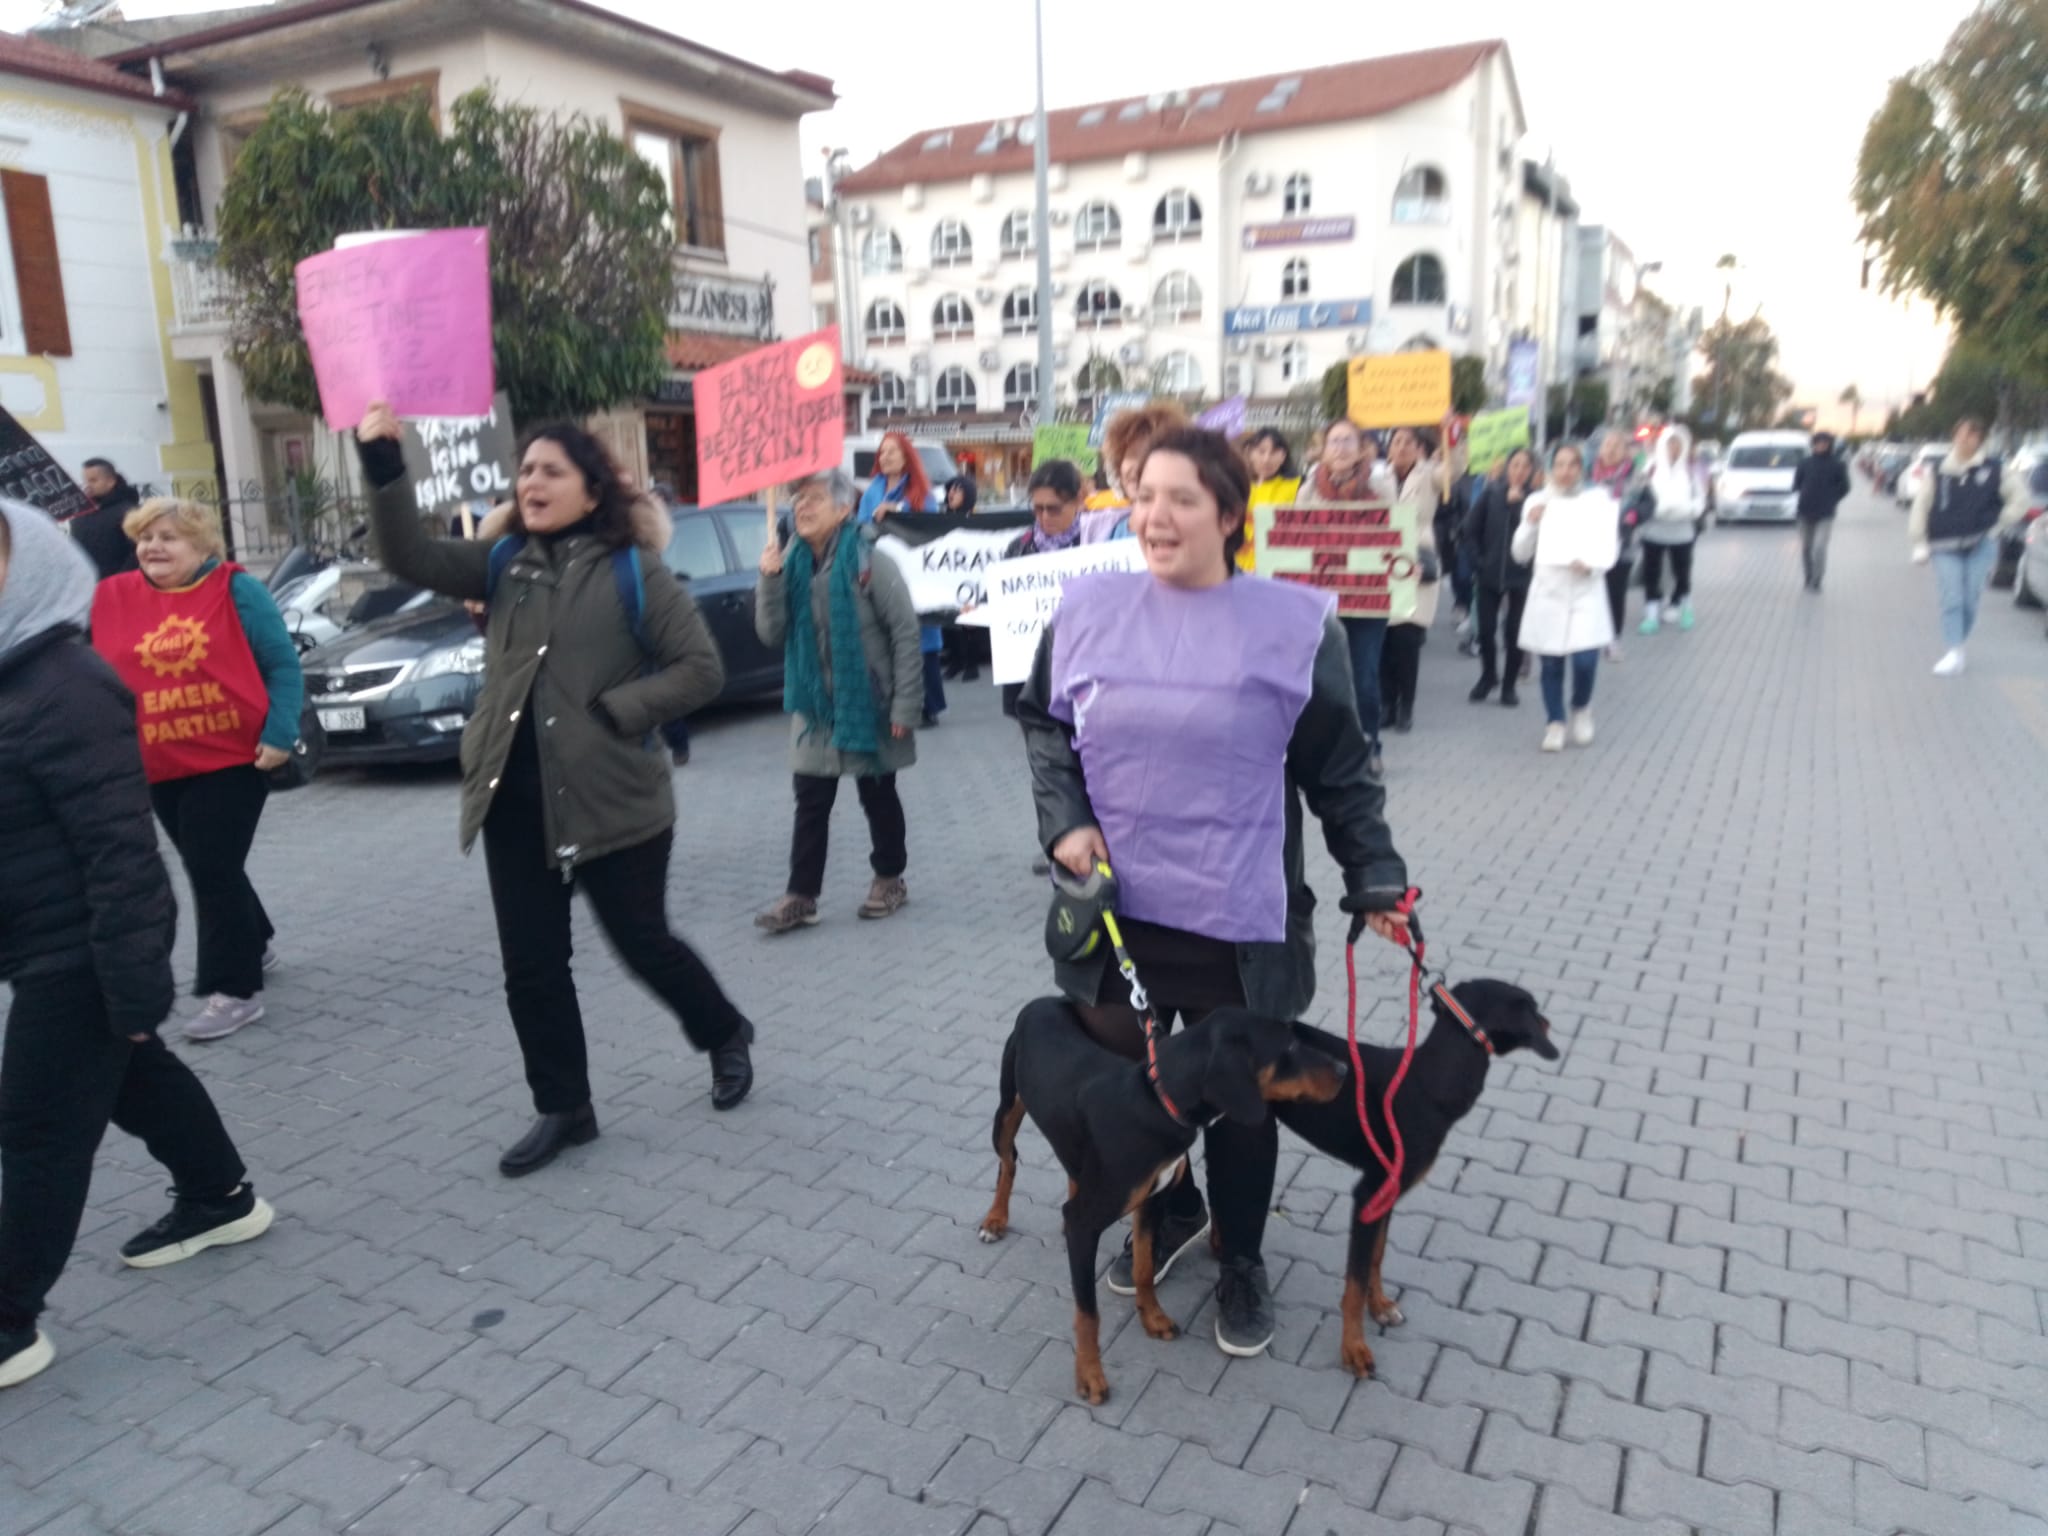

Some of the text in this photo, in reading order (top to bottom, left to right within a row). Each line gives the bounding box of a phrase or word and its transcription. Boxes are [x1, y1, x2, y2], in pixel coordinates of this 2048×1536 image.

[470, 460, 510, 493] OL
[142, 682, 225, 715] EMEK
[142, 704, 240, 745] PARTİSİ
